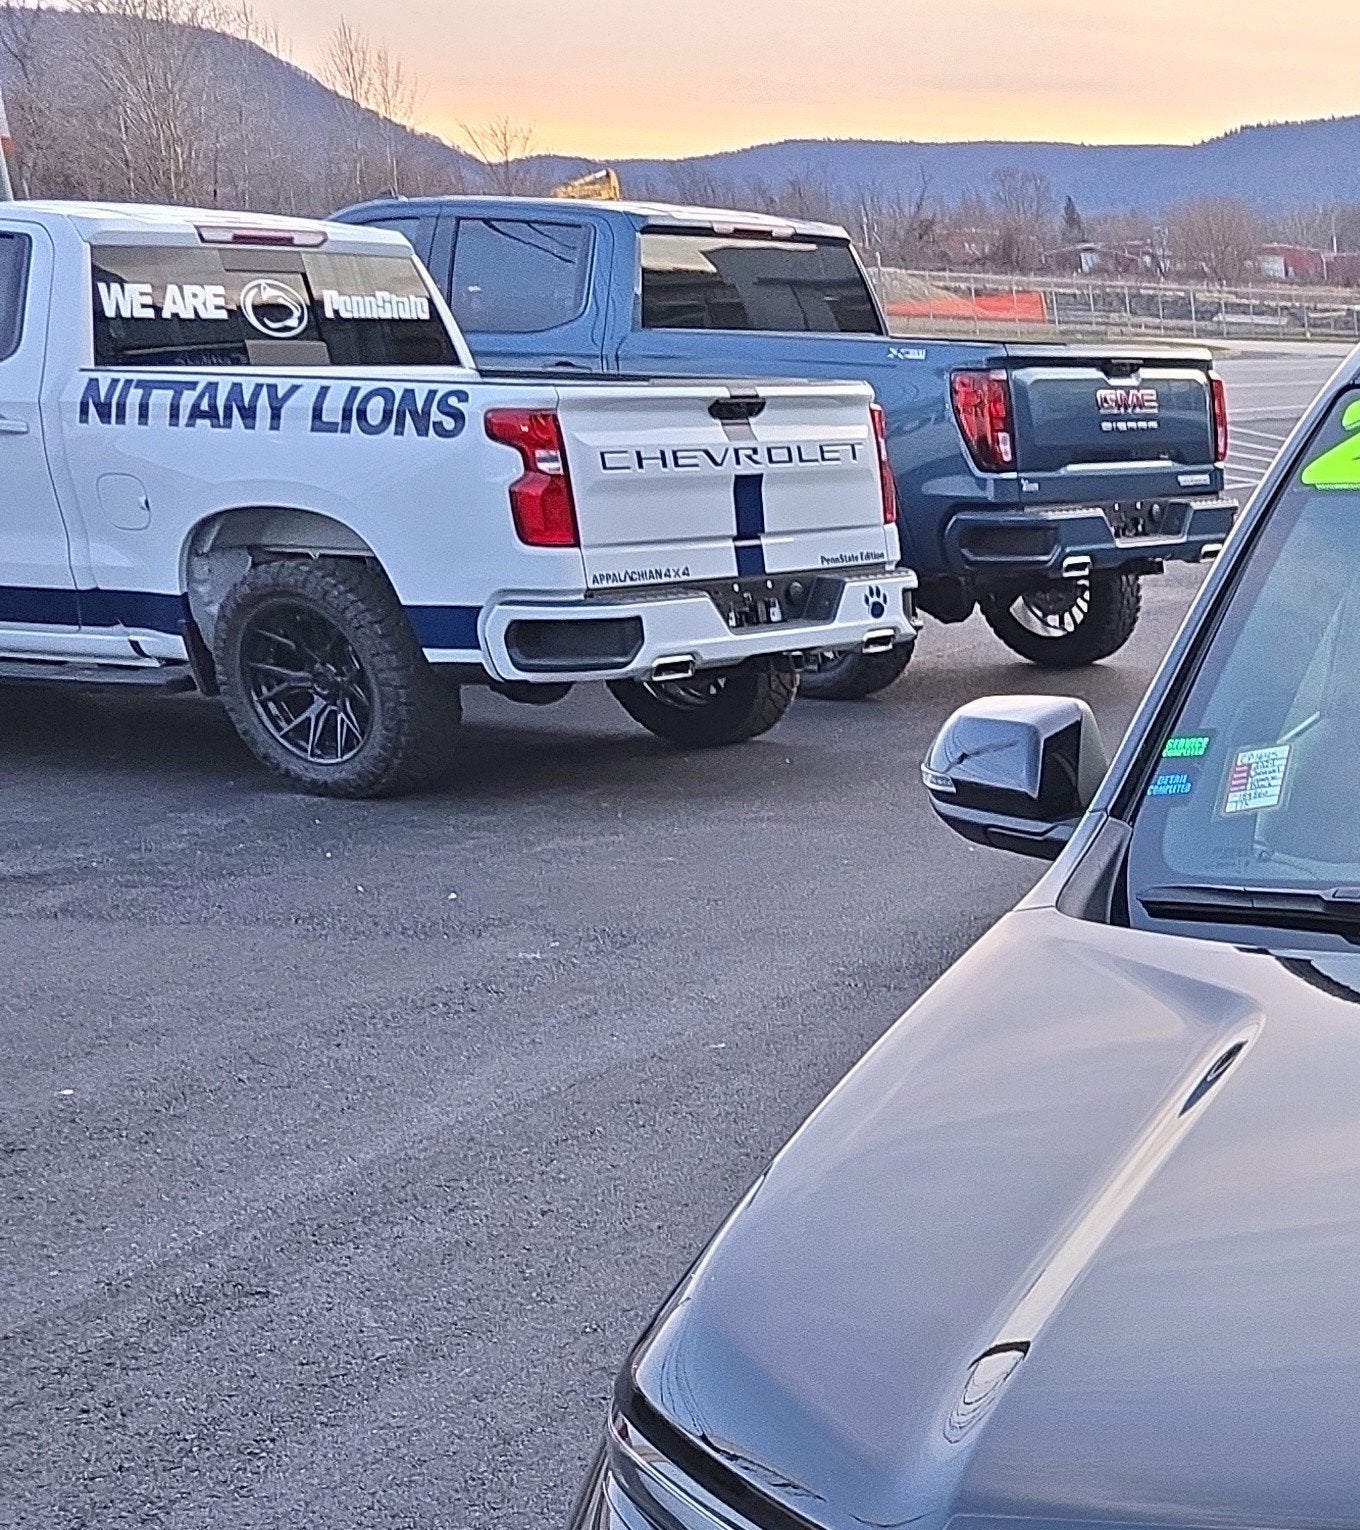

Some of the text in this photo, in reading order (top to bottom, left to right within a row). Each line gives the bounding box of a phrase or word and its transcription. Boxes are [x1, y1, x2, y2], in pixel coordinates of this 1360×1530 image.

[97, 282, 229, 320] WE ARE
[79, 376, 470, 439] NITTANY LIONS
[600, 442, 864, 472] CHEVROLET
